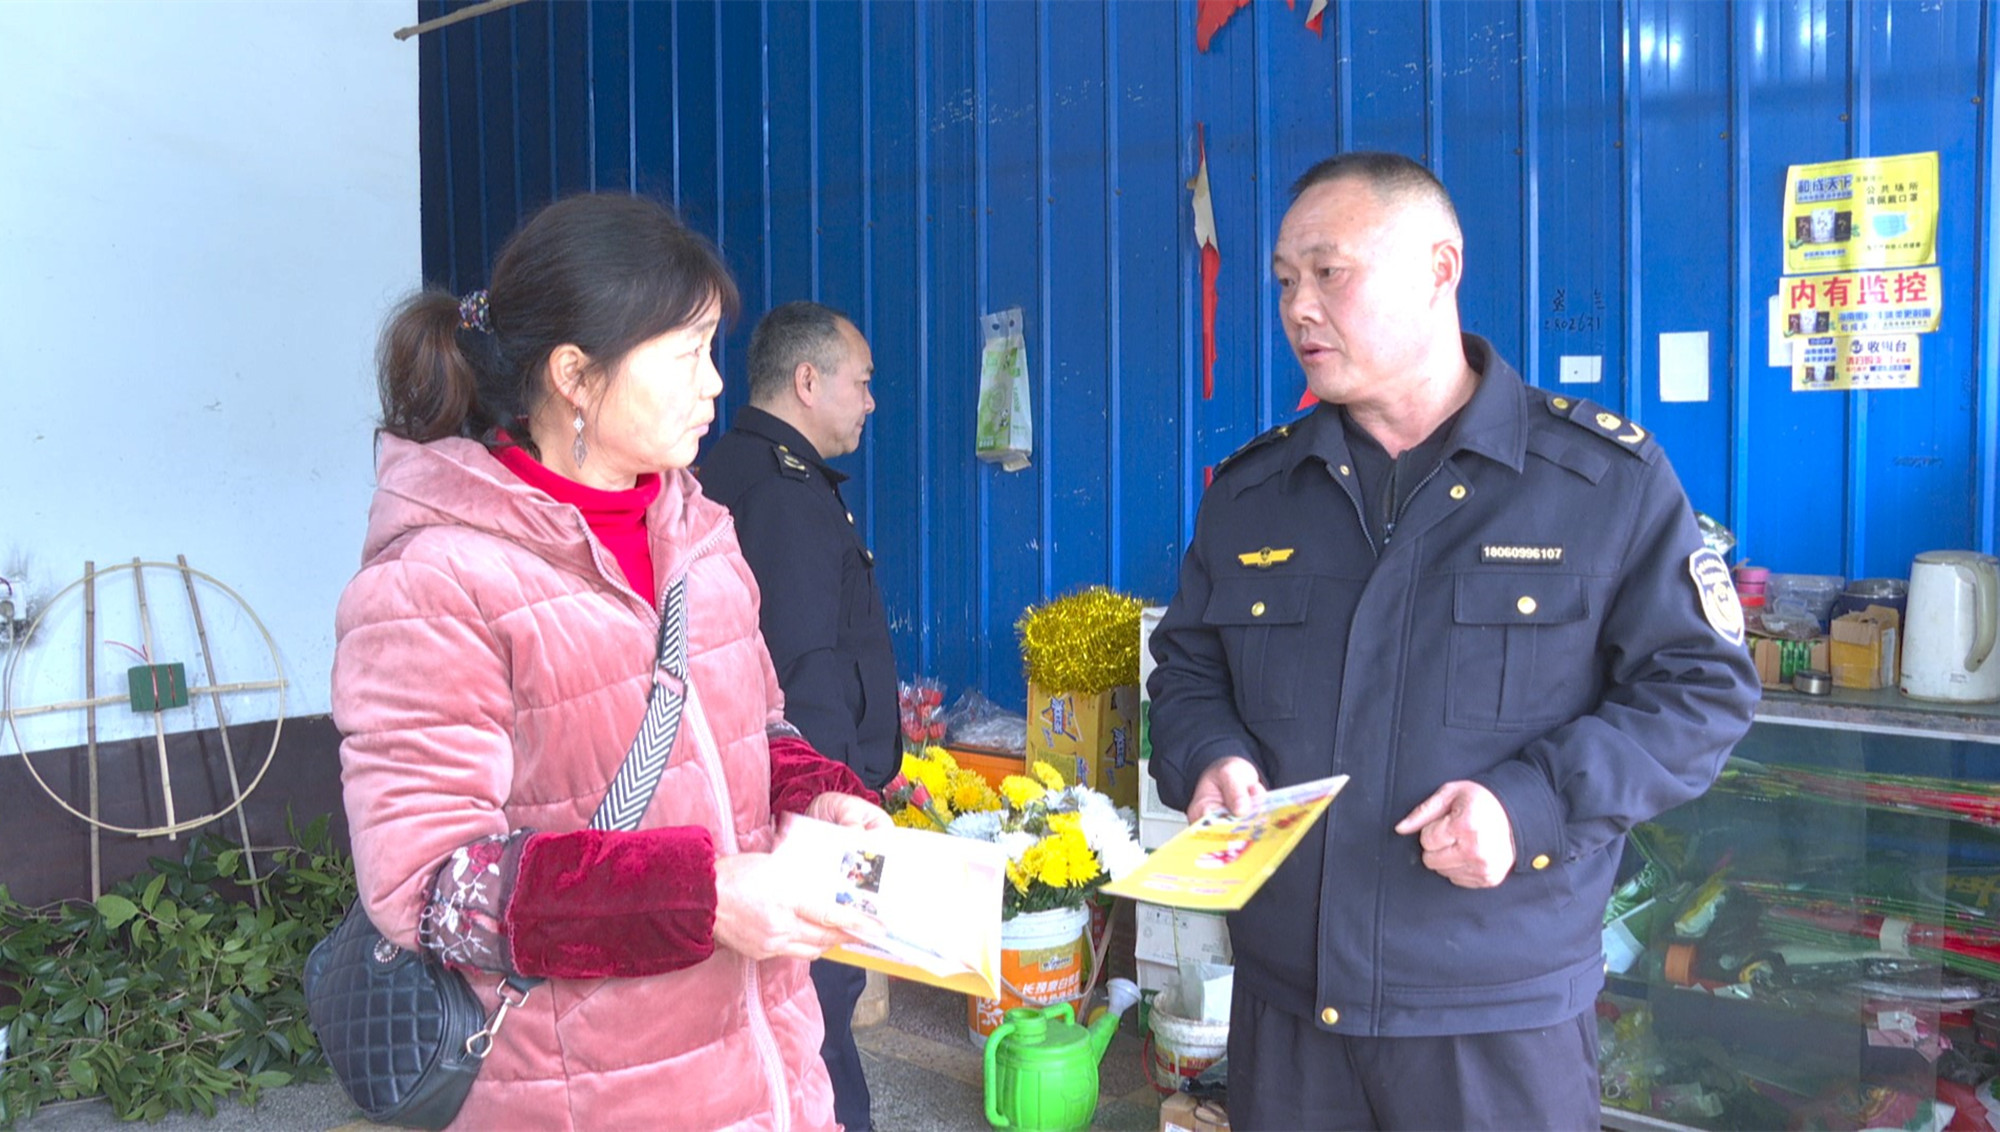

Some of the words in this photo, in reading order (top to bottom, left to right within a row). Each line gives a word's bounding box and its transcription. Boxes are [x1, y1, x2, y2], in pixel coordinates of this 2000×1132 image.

[1866, 182, 1919, 195] 公共场所
[1790, 271, 1928, 309] 内有监控
